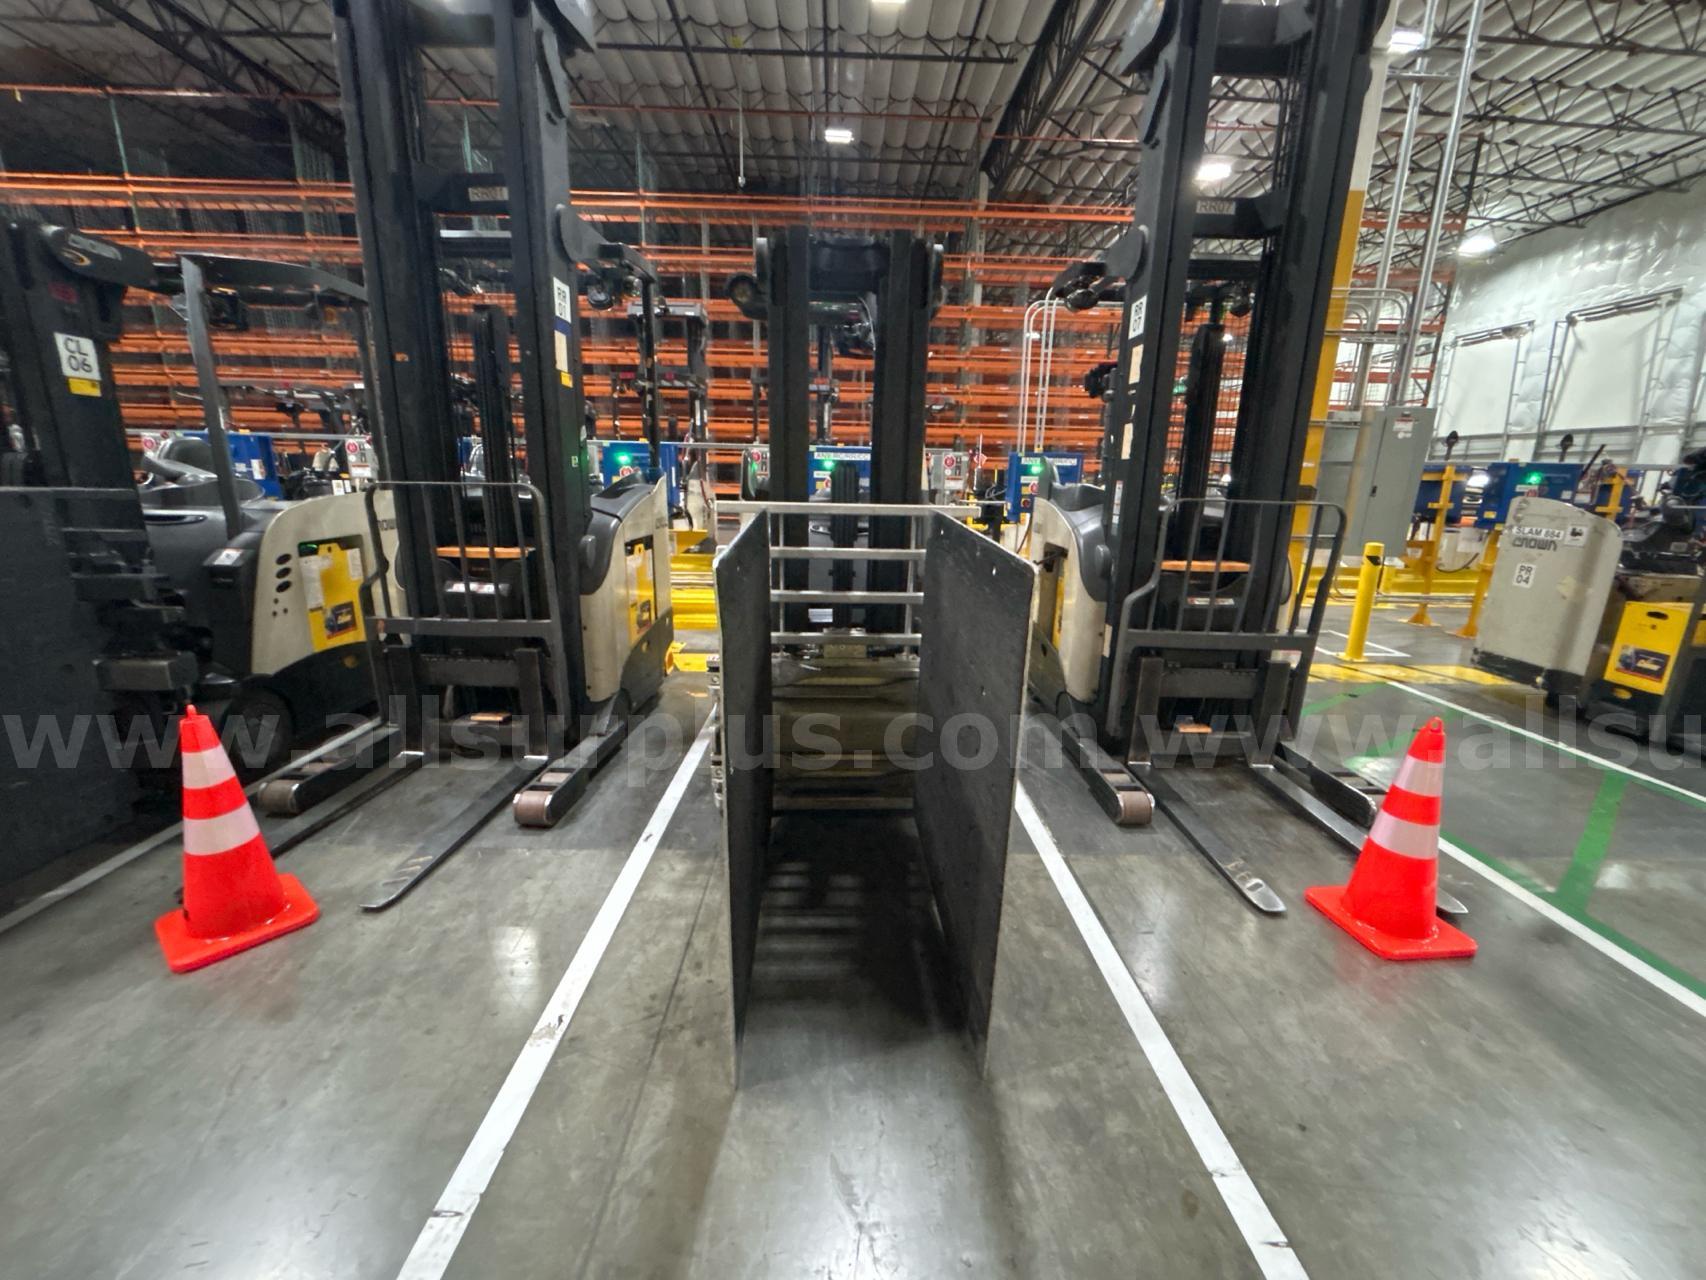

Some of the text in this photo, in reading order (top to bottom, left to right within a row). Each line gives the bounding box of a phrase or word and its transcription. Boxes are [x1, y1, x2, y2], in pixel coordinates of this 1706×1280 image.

[64, 337, 89, 357] CL
[69, 355, 93, 373] 06
[1515, 526, 1542, 535] SLAM
[1519, 564, 1533, 576] PR
[1516, 574, 1530, 585] 04
